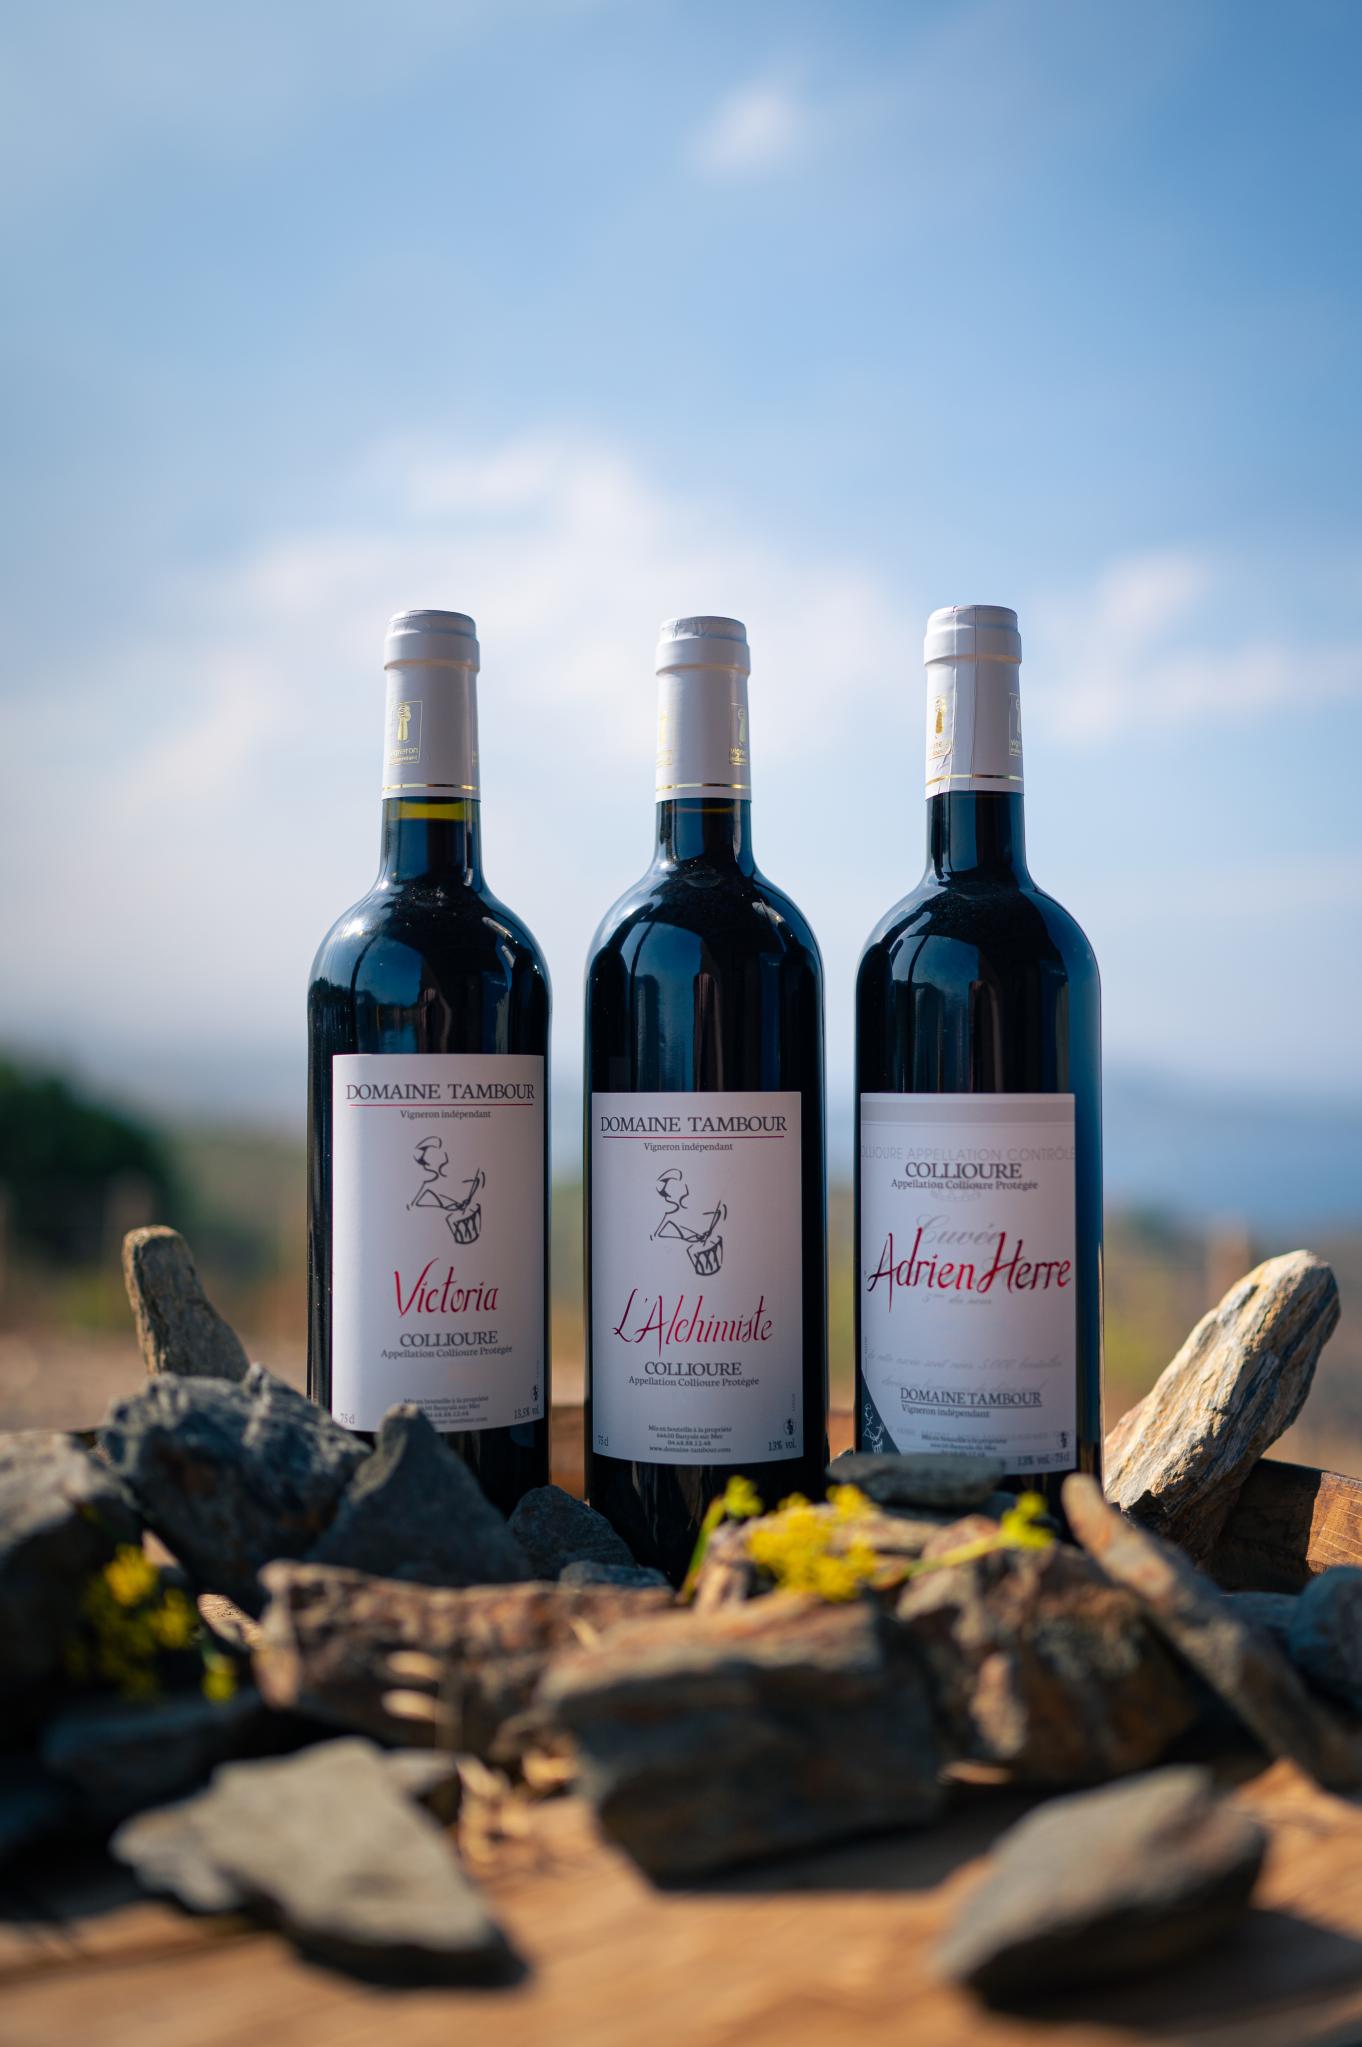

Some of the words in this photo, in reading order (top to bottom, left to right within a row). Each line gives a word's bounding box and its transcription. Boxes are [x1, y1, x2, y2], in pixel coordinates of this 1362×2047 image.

[346, 1084, 440, 1100] DOMAINE
[447, 1083, 535, 1100] TAMBOUR
[400, 1110, 440, 1119] Vigneron
[441, 1109, 491, 1120] indépendant
[600, 1116, 681, 1132] DOMAINE
[688, 1116, 787, 1132] TAMBOUR
[643, 1142, 680, 1152] Vigneron
[681, 1142, 733, 1152] indépendant
[906, 1147, 1002, 1161] APPELLATION
[905, 1162, 1022, 1180] COLLIOURE
[891, 1179, 944, 1190] Appellation
[945, 1179, 993, 1190] Collioure
[995, 1179, 1038, 1191] Protégée
[394, 1257, 499, 1318] Victoria
[611, 1288, 773, 1358] L'Alchimiste
[400, 1331, 498, 1348] COLLIOURE
[381, 1349, 435, 1360] Appellation
[436, 1348, 478, 1359] Collioure
[480, 1345, 513, 1356] Protégée
[644, 1361, 742, 1377] COLLIOURE
[628, 1376, 677, 1388] Appellation
[678, 1377, 721, 1388] Collioure
[722, 1376, 760, 1388] Protégée
[900, 1387, 965, 1405] DOMAINE
[967, 1391, 1042, 1406] TAMBOUR
[901, 1404, 936, 1417] Vigneron
[937, 1407, 991, 1419] indépendant
